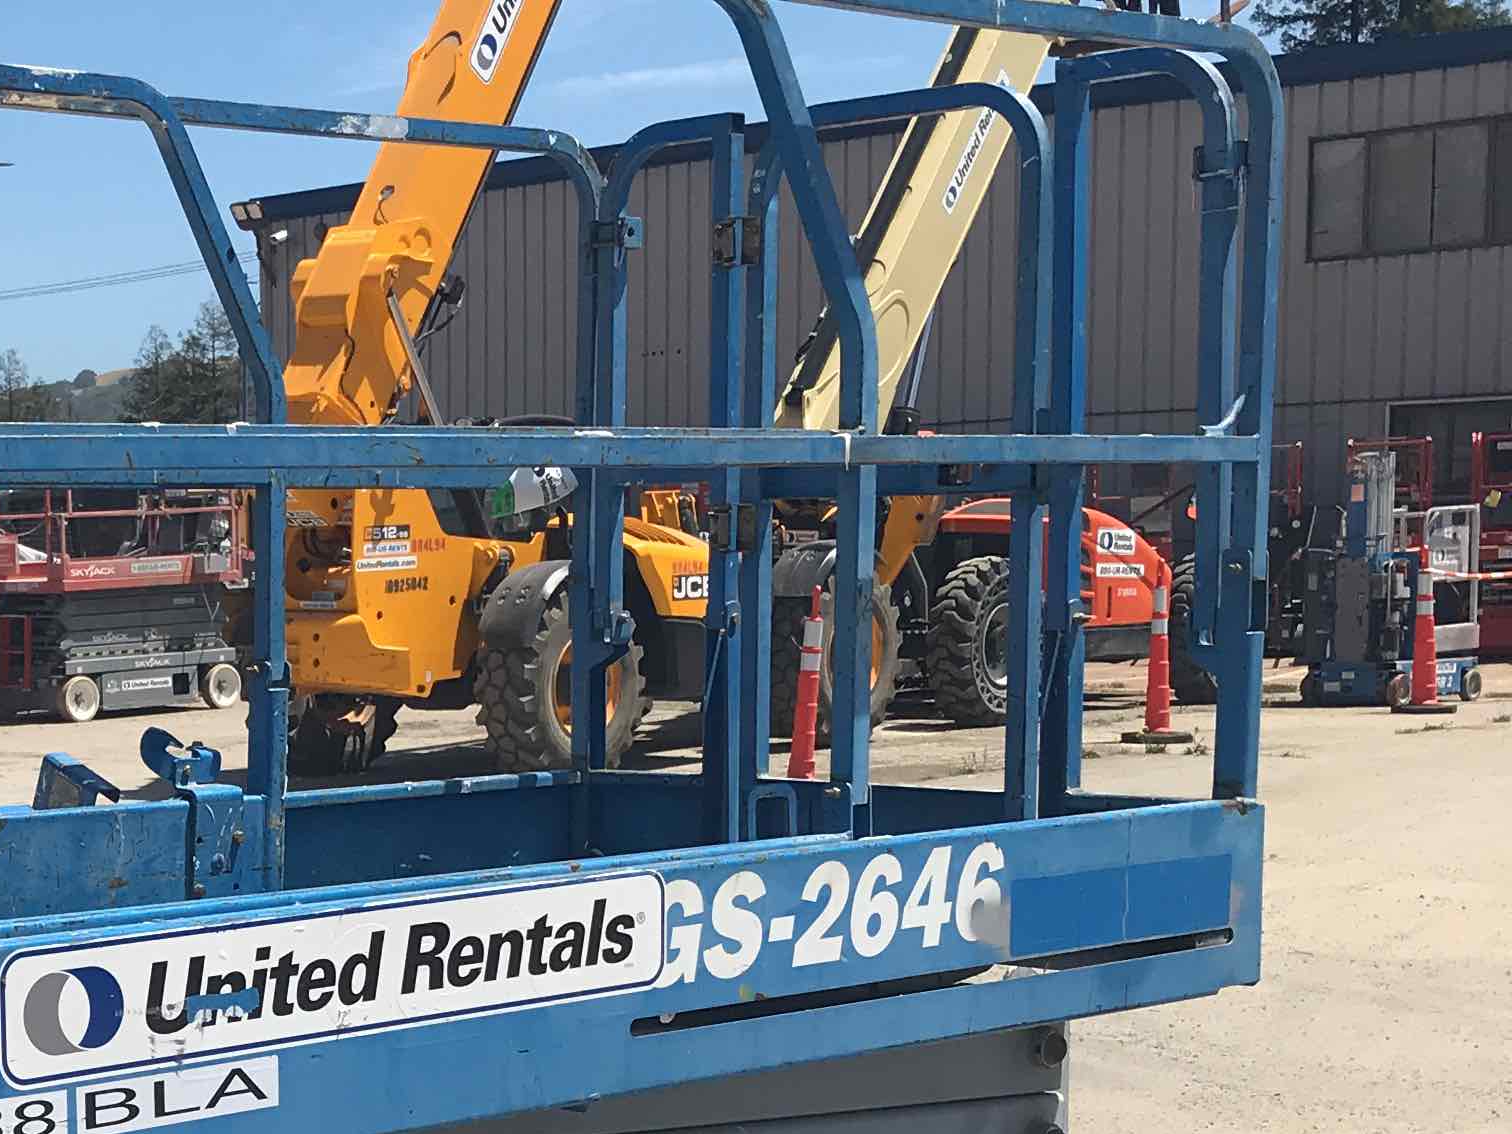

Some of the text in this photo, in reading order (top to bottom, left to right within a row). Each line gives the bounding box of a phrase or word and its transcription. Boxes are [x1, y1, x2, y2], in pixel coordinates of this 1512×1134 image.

[955, 134, 981, 188] United
[70, 564, 116, 578] SKYJACK
[654, 842, 1008, 988] GS-2646
[145, 898, 636, 1035] United Rentals
[84, 1067, 269, 1131] BLA
